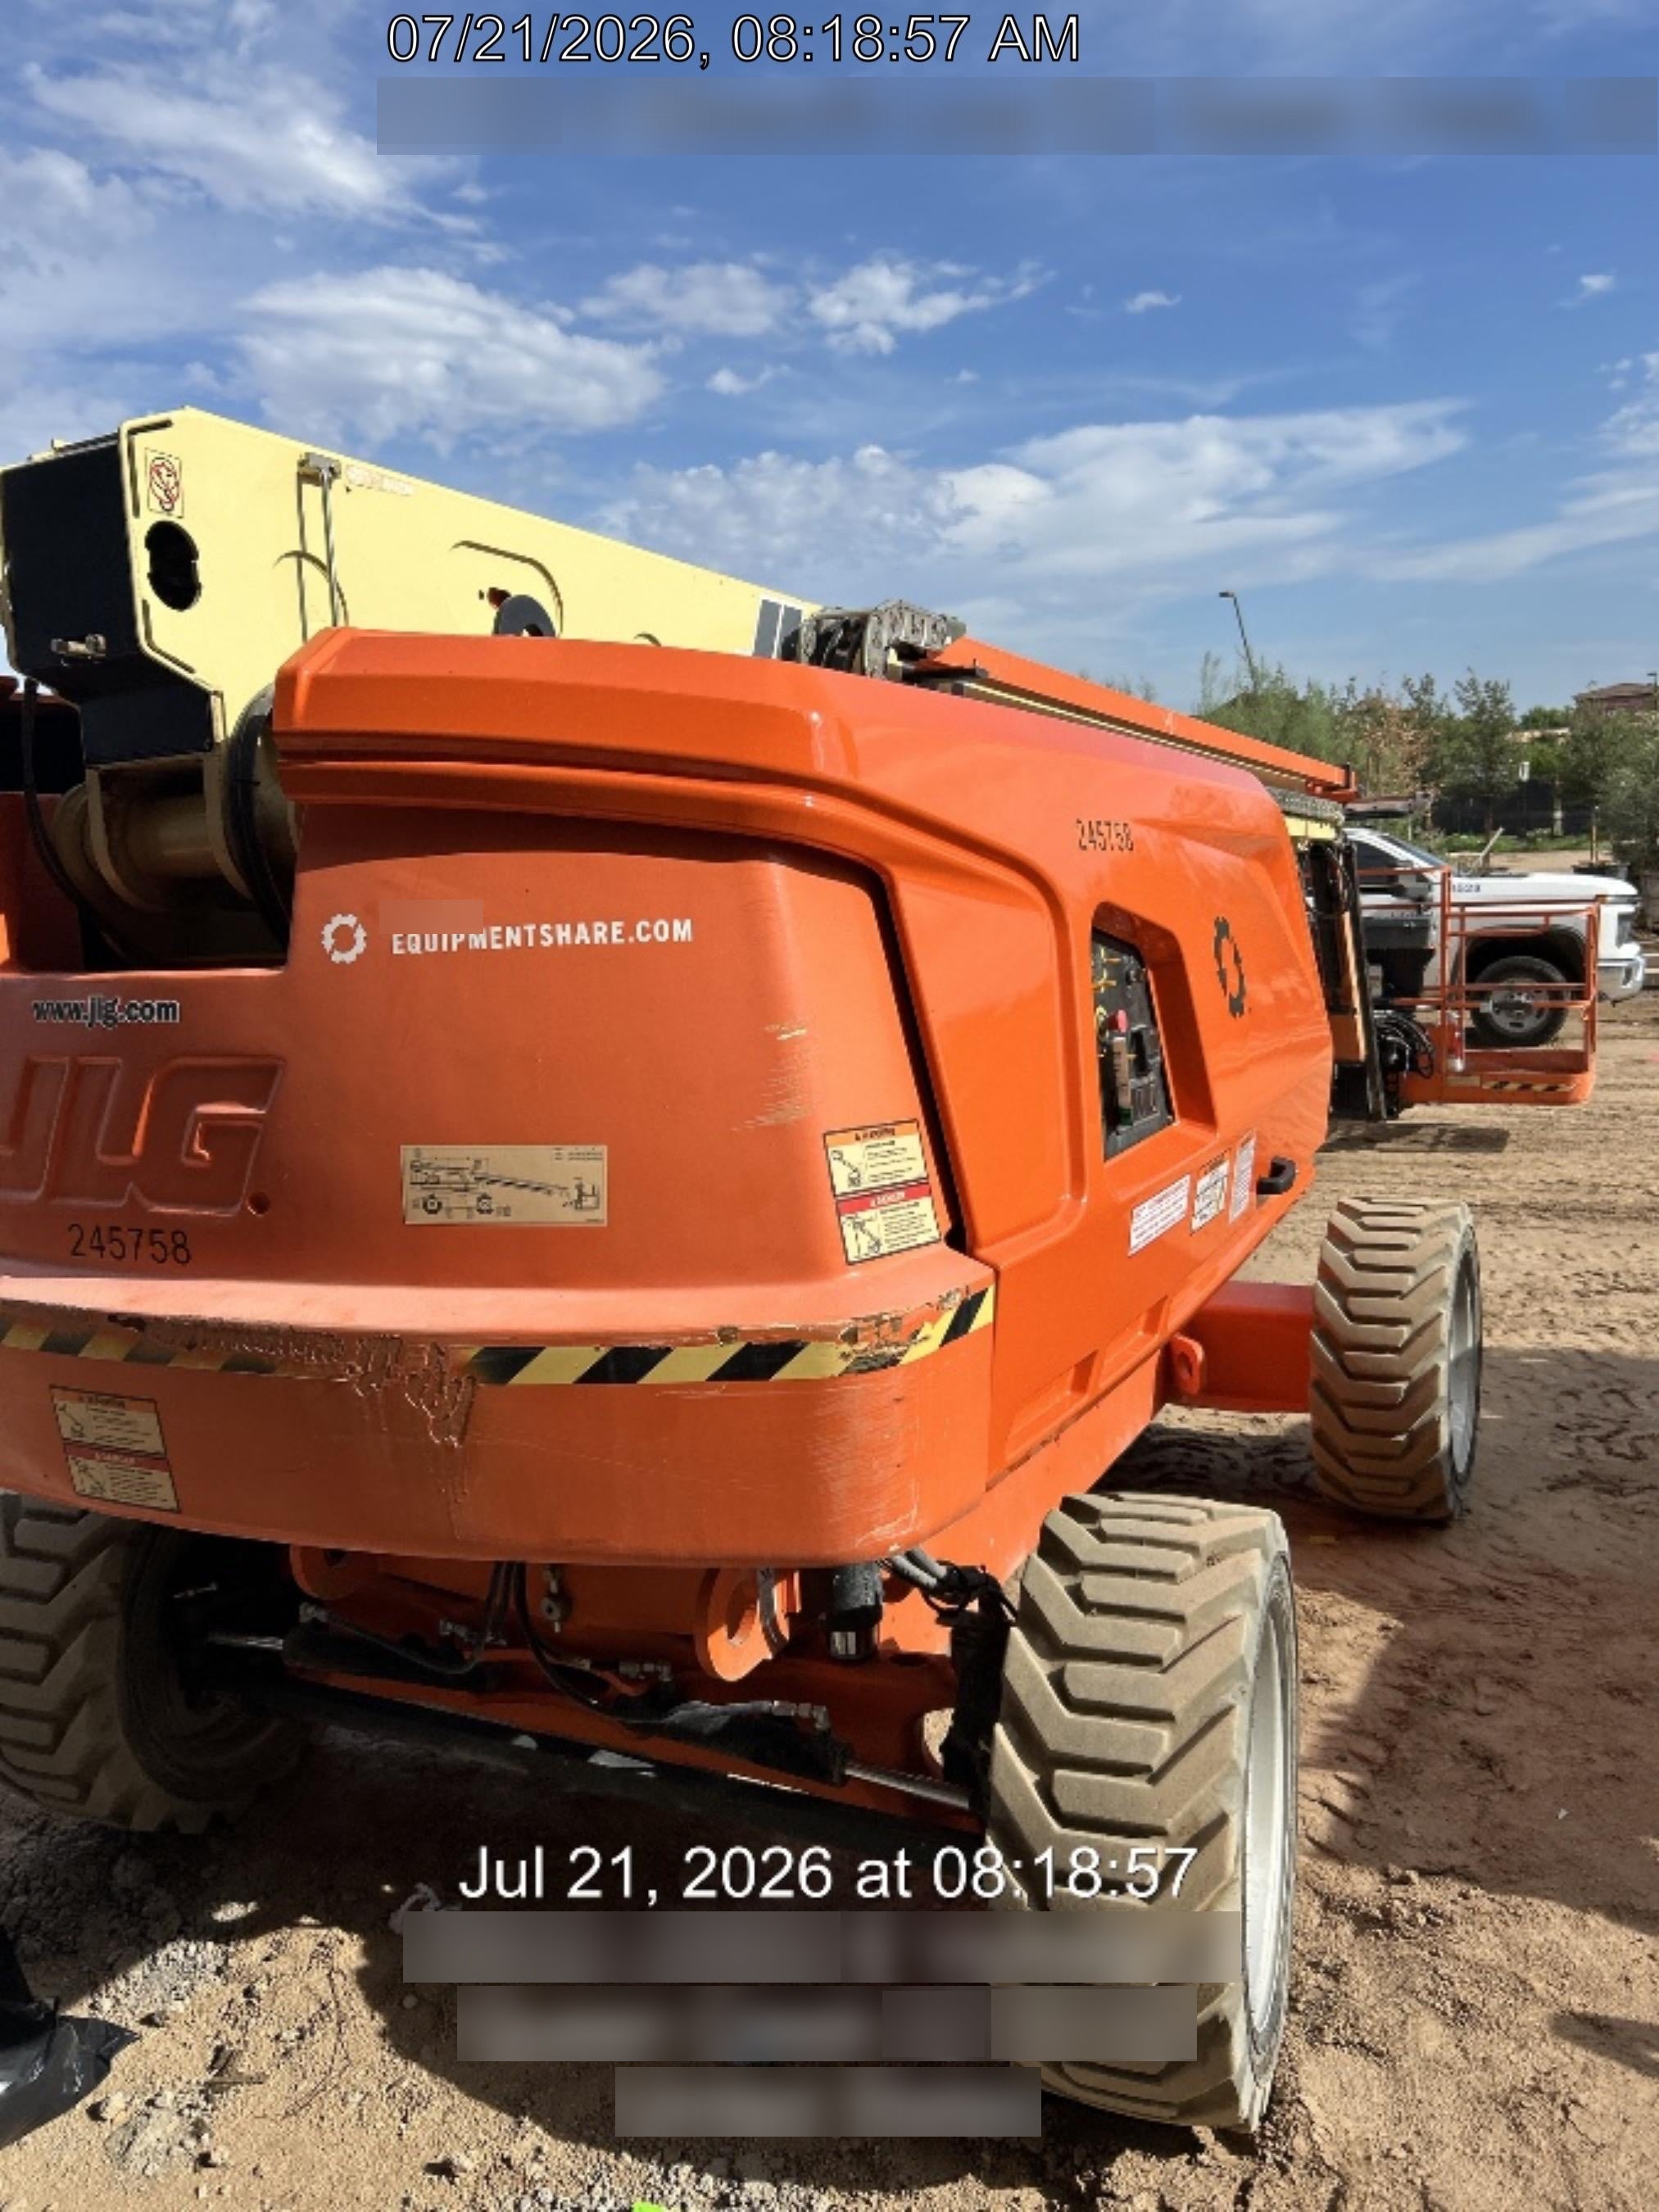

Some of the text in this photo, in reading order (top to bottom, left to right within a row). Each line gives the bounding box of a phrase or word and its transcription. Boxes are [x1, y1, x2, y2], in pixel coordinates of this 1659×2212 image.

[1076, 818, 1135, 852] 245758
[391, 918, 694, 955] EQUIPMENTSHARE.COM
[32, 995, 181, 1030] www.jlg.com
[67, 1223, 193, 1266] 245758
